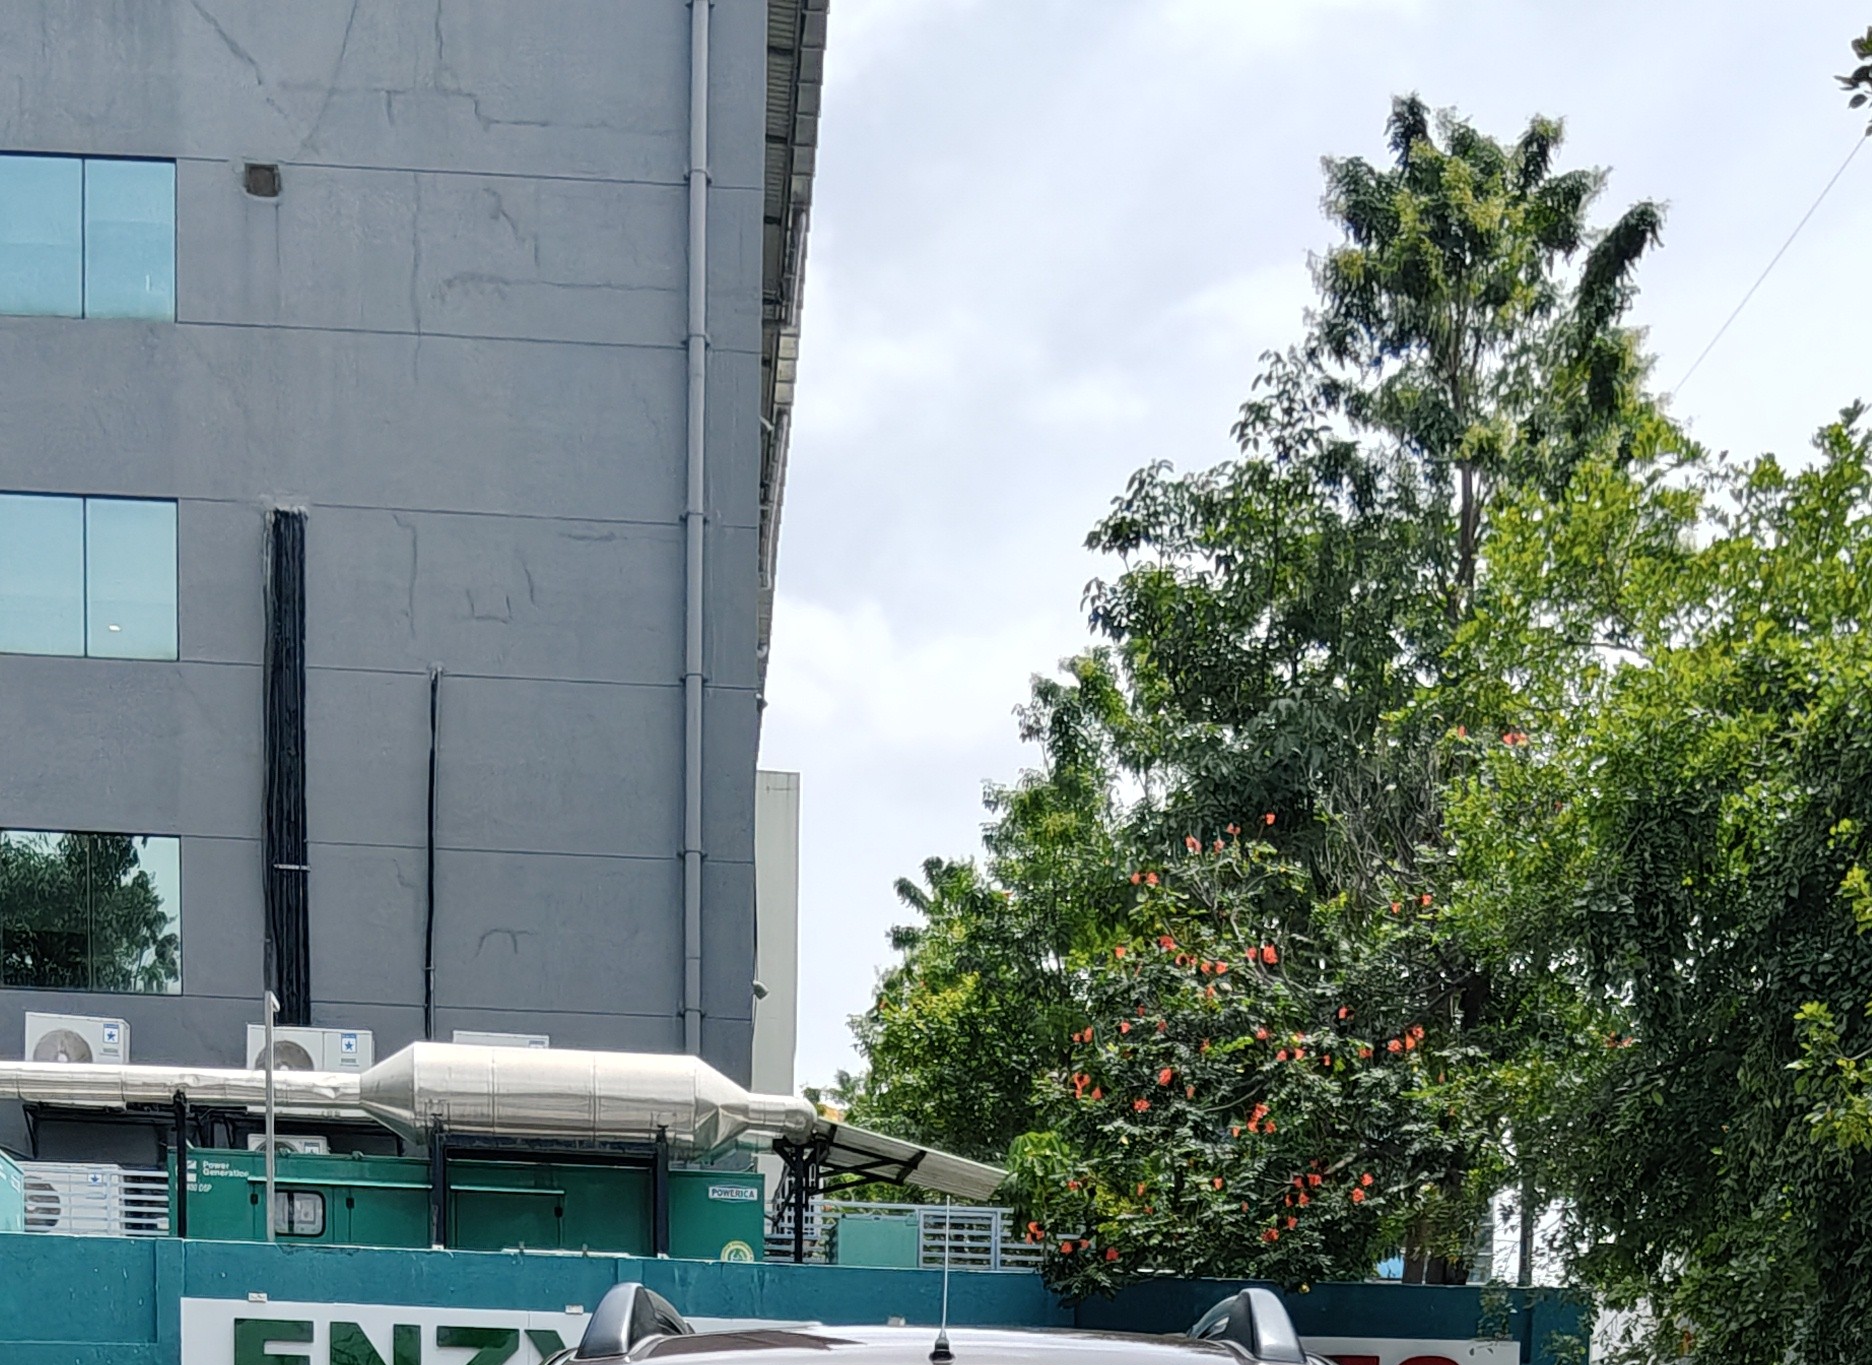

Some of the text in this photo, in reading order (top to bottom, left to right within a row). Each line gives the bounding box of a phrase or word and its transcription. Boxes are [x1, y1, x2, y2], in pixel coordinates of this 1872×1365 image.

[203, 1160, 229, 1169] Power
[203, 1169, 249, 1178] Generation
[711, 1188, 755, 1198] POWERICA
